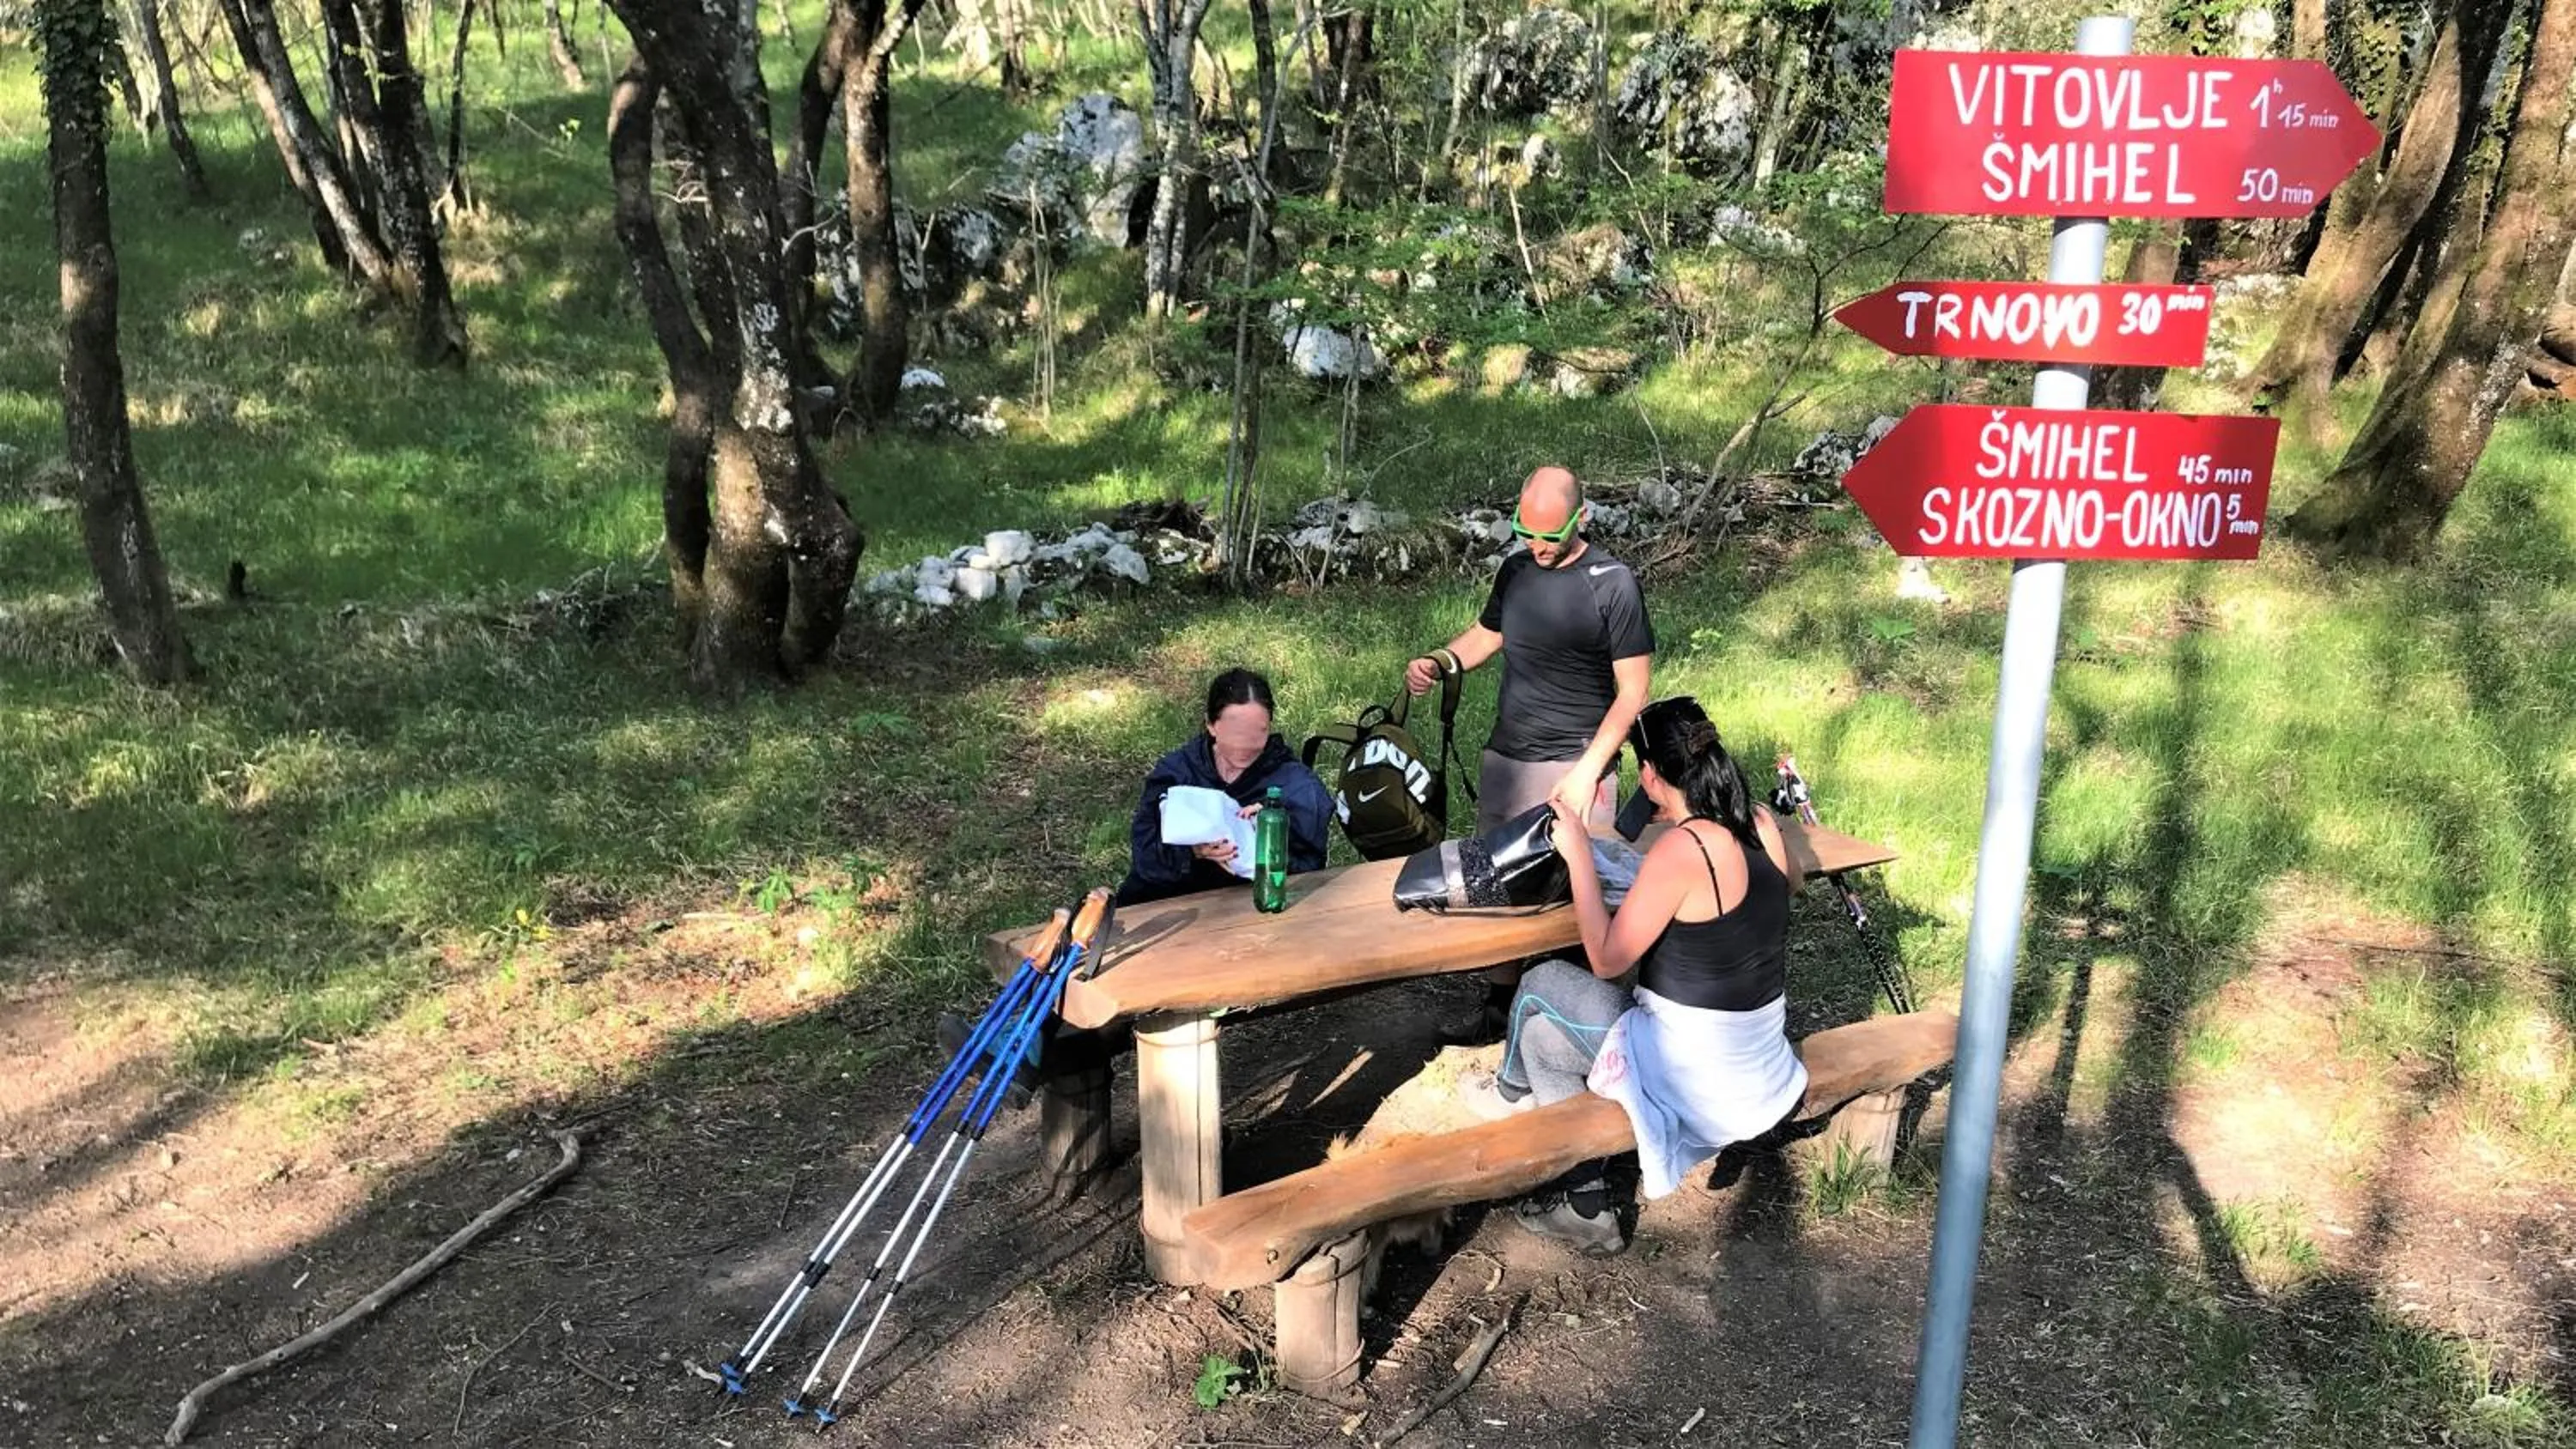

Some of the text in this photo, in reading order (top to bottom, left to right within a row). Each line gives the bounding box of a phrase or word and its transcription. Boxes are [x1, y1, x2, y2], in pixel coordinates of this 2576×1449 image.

[1947, 62, 2233, 131] VITOVLJE
[2277, 102, 2306, 128] 15
[2309, 112, 2339, 128] min
[1981, 131, 2315, 204] ŠMIHEL 50 min
[1897, 287, 2207, 351] TRNOVO 30 min
[1975, 409, 2253, 484] ŠMIHEL 45 min
[1918, 487, 2259, 549] SKOZNO-OKNO 5 min
